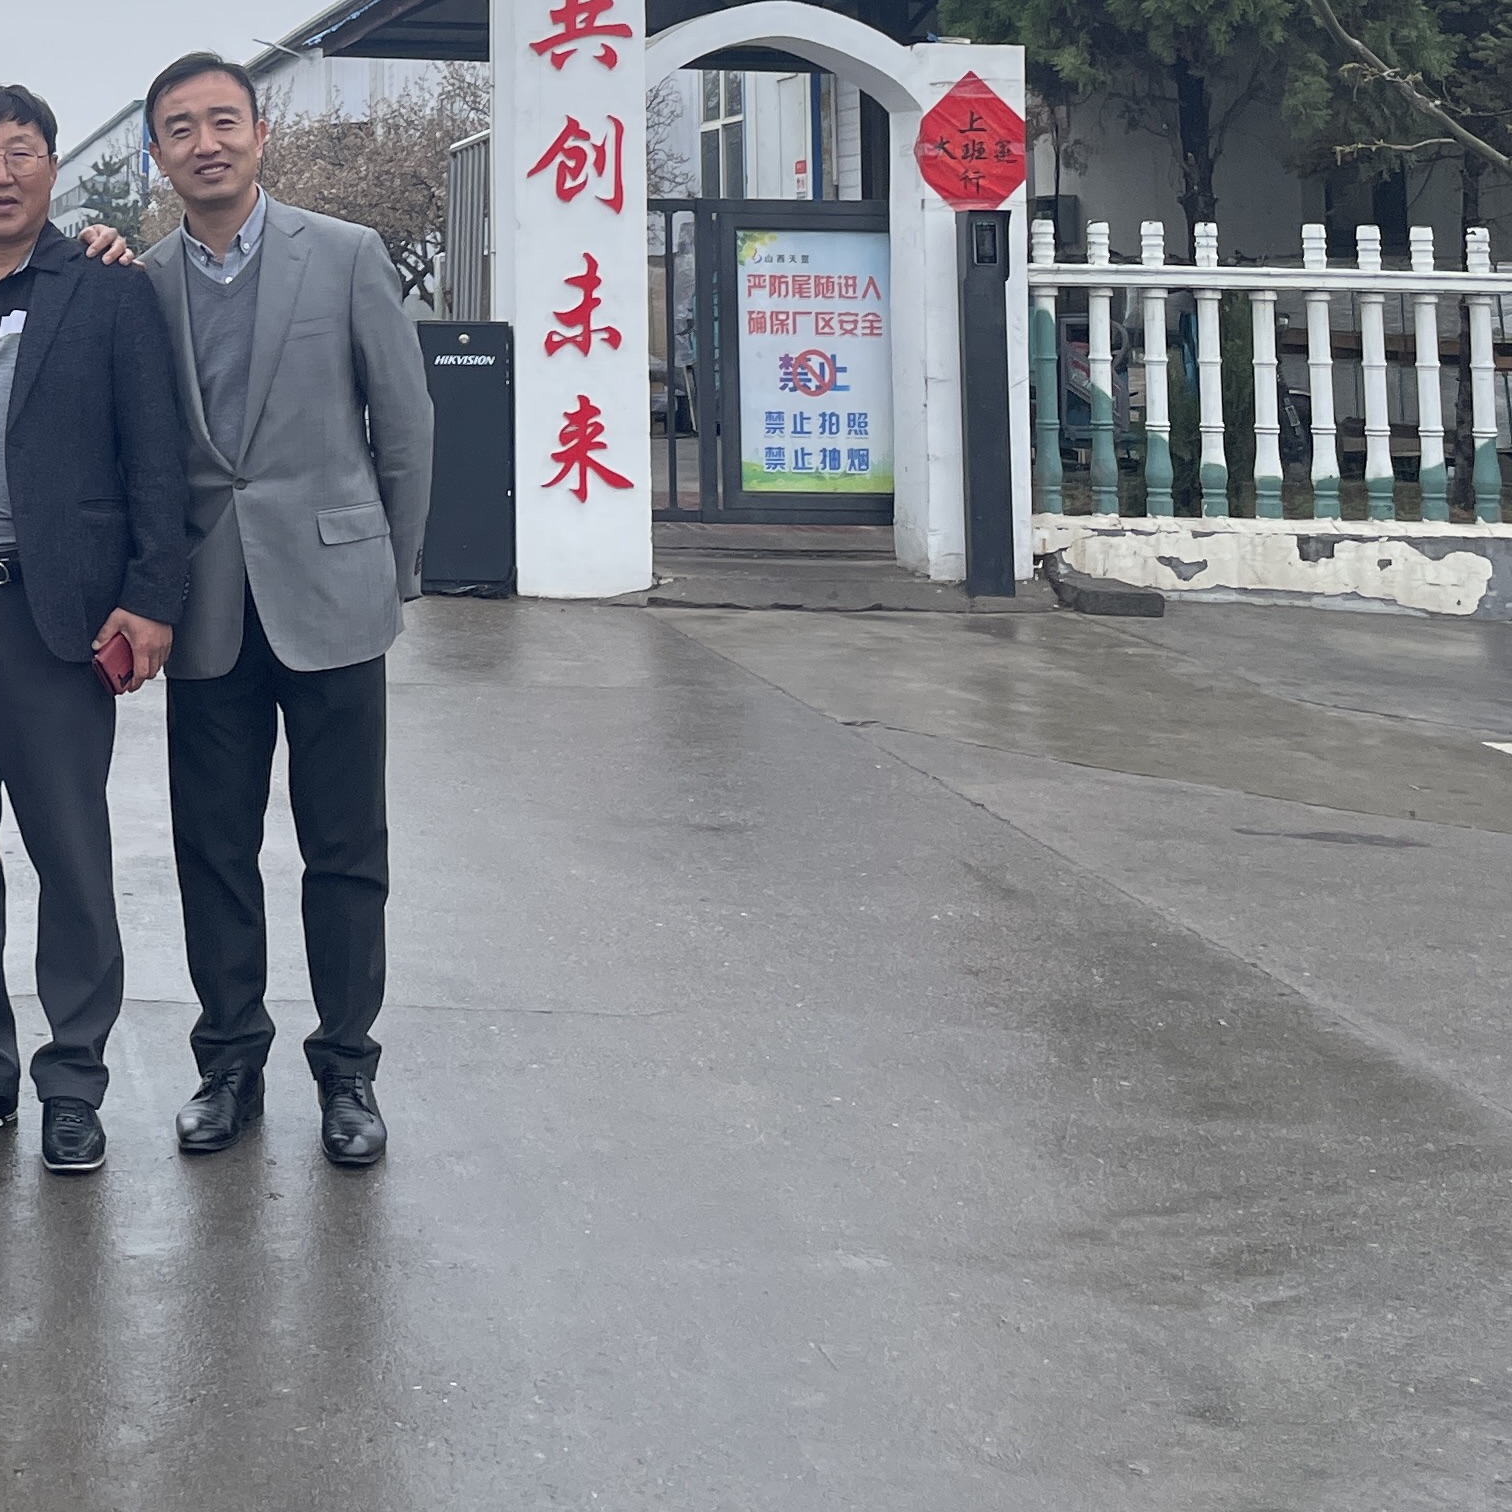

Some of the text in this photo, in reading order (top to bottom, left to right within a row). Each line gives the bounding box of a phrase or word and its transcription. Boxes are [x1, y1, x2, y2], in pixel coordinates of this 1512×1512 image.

[746, 311, 883, 337] 确保厂区安全
[434, 355, 496, 365] HIKVISION
[764, 410, 869, 436] 禁止拍照
[764, 446, 870, 472] 禁止抽烟
